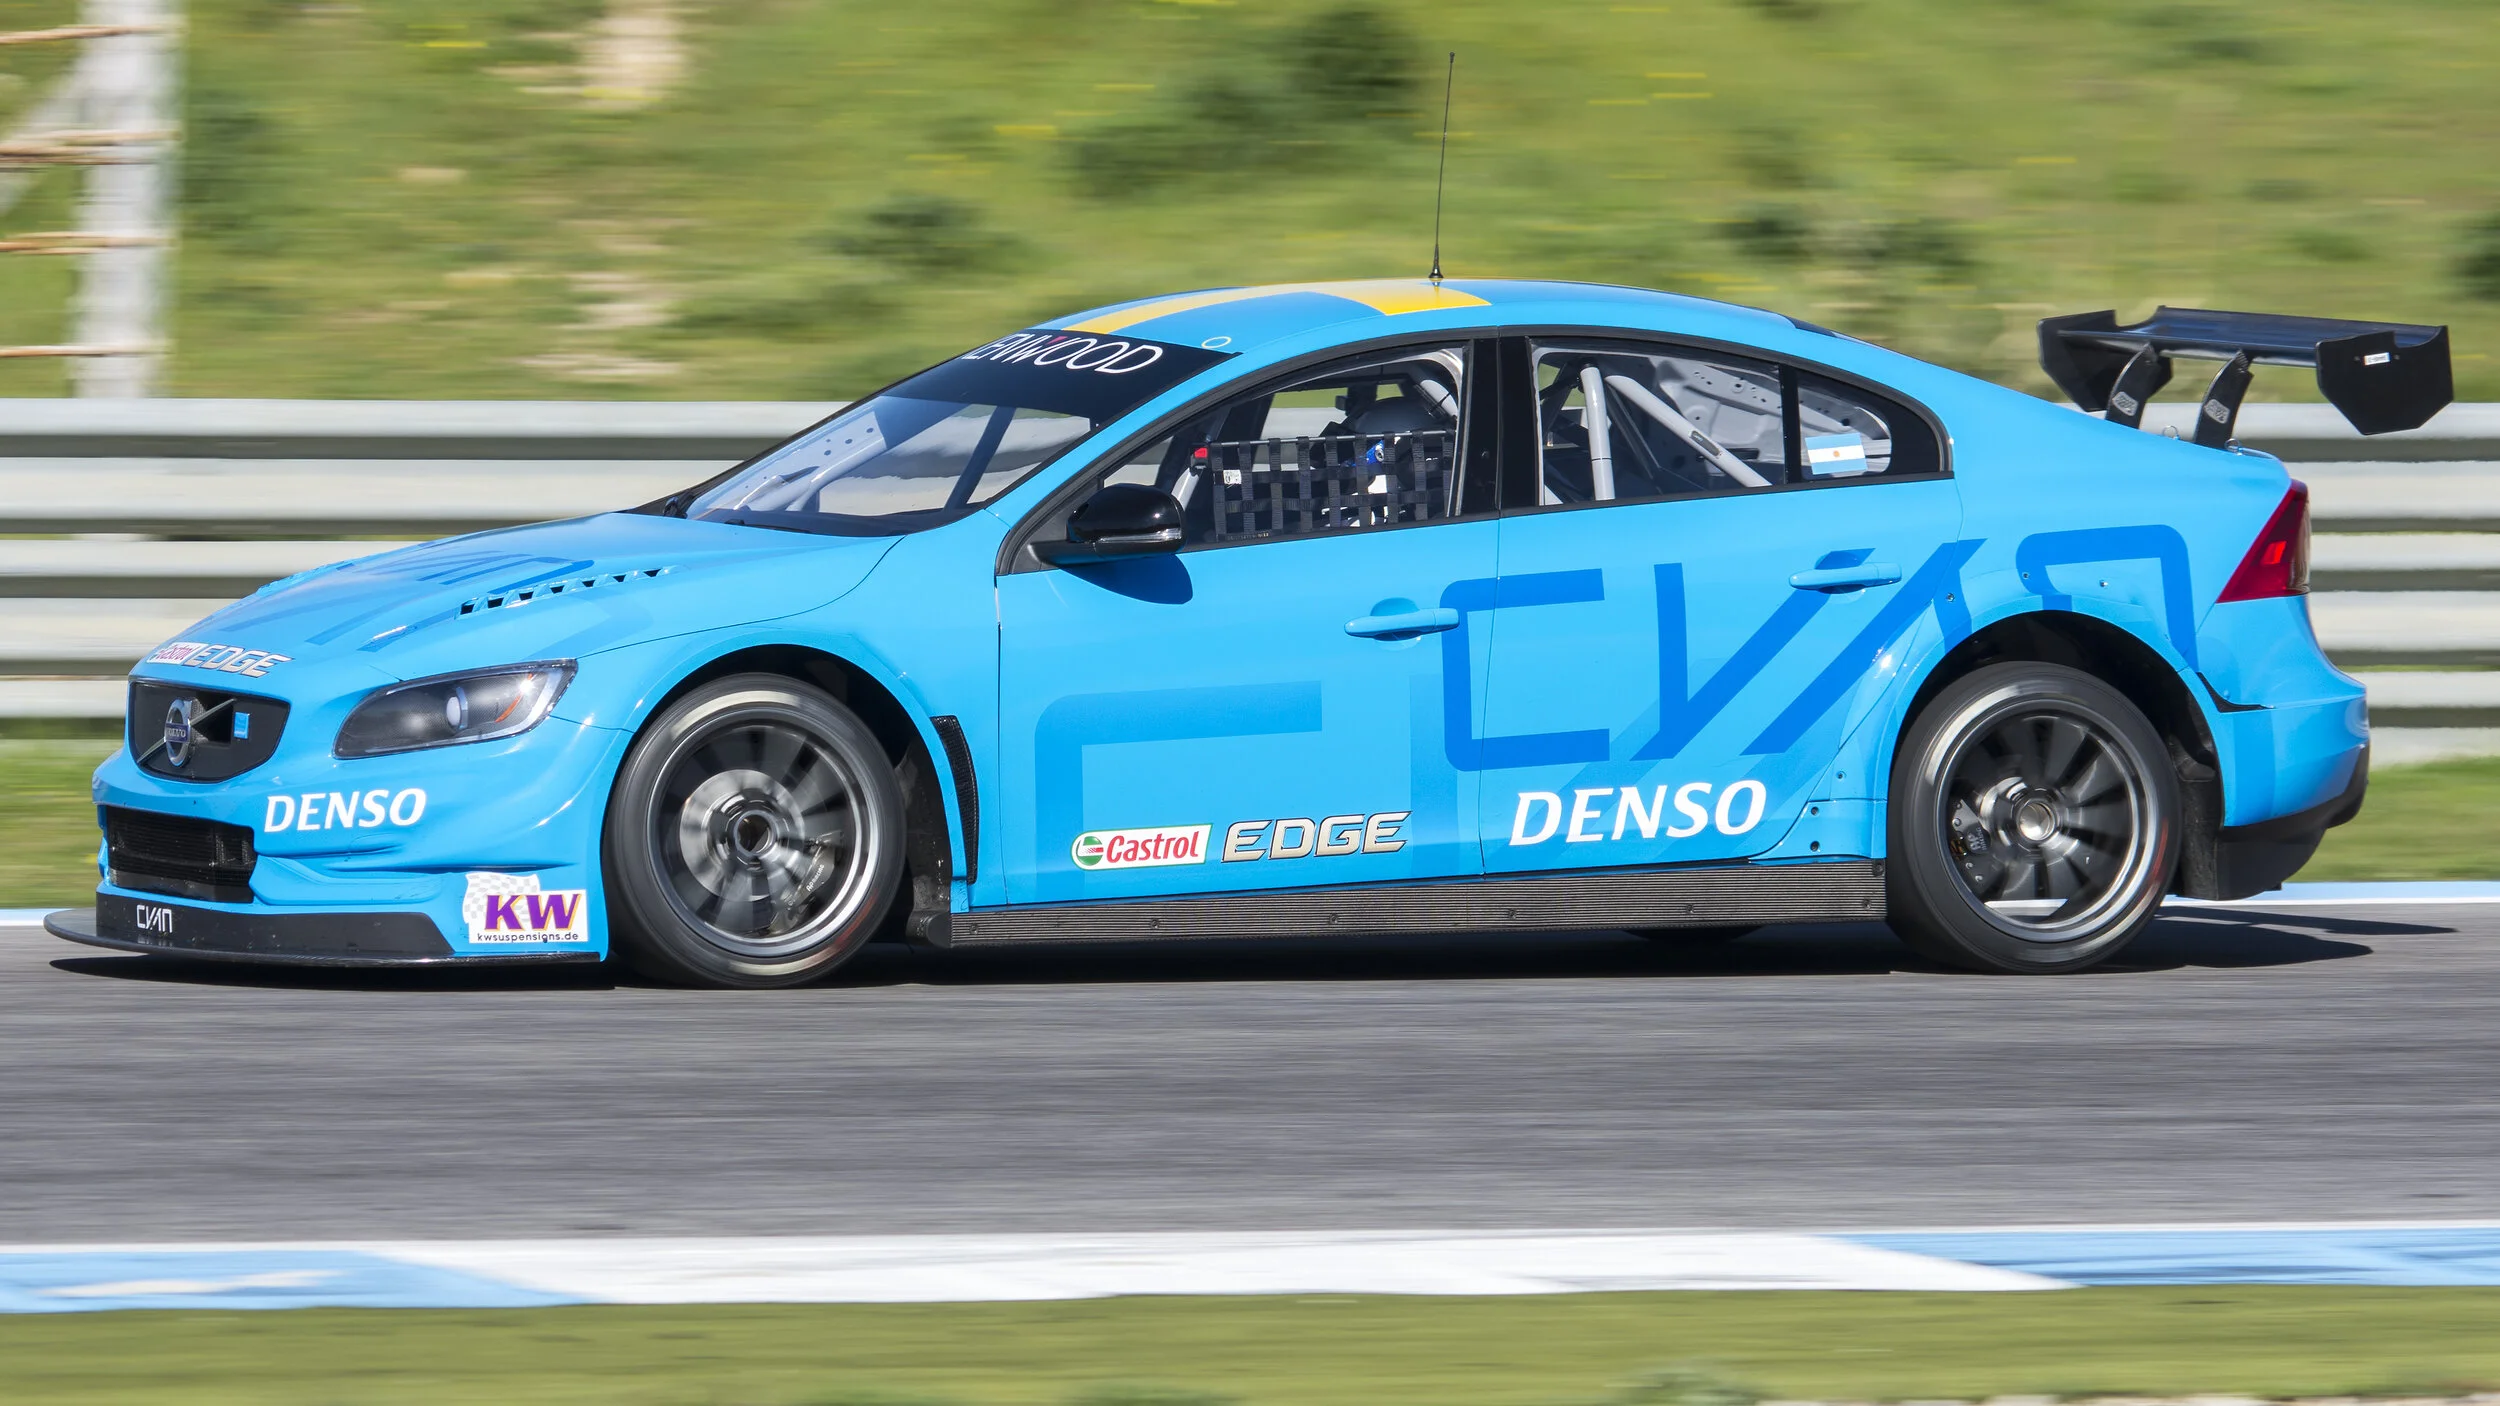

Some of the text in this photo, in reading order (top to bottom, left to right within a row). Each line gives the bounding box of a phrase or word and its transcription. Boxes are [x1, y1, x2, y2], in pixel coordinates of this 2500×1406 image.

[961, 333, 1163, 374] ENWOOD
[182, 644, 294, 678] EDGE
[264, 788, 427, 833] DENSO
[1509, 780, 1767, 846] DENSO
[1106, 811, 1412, 863] Castrol EDGE
[484, 893, 582, 931] KW
